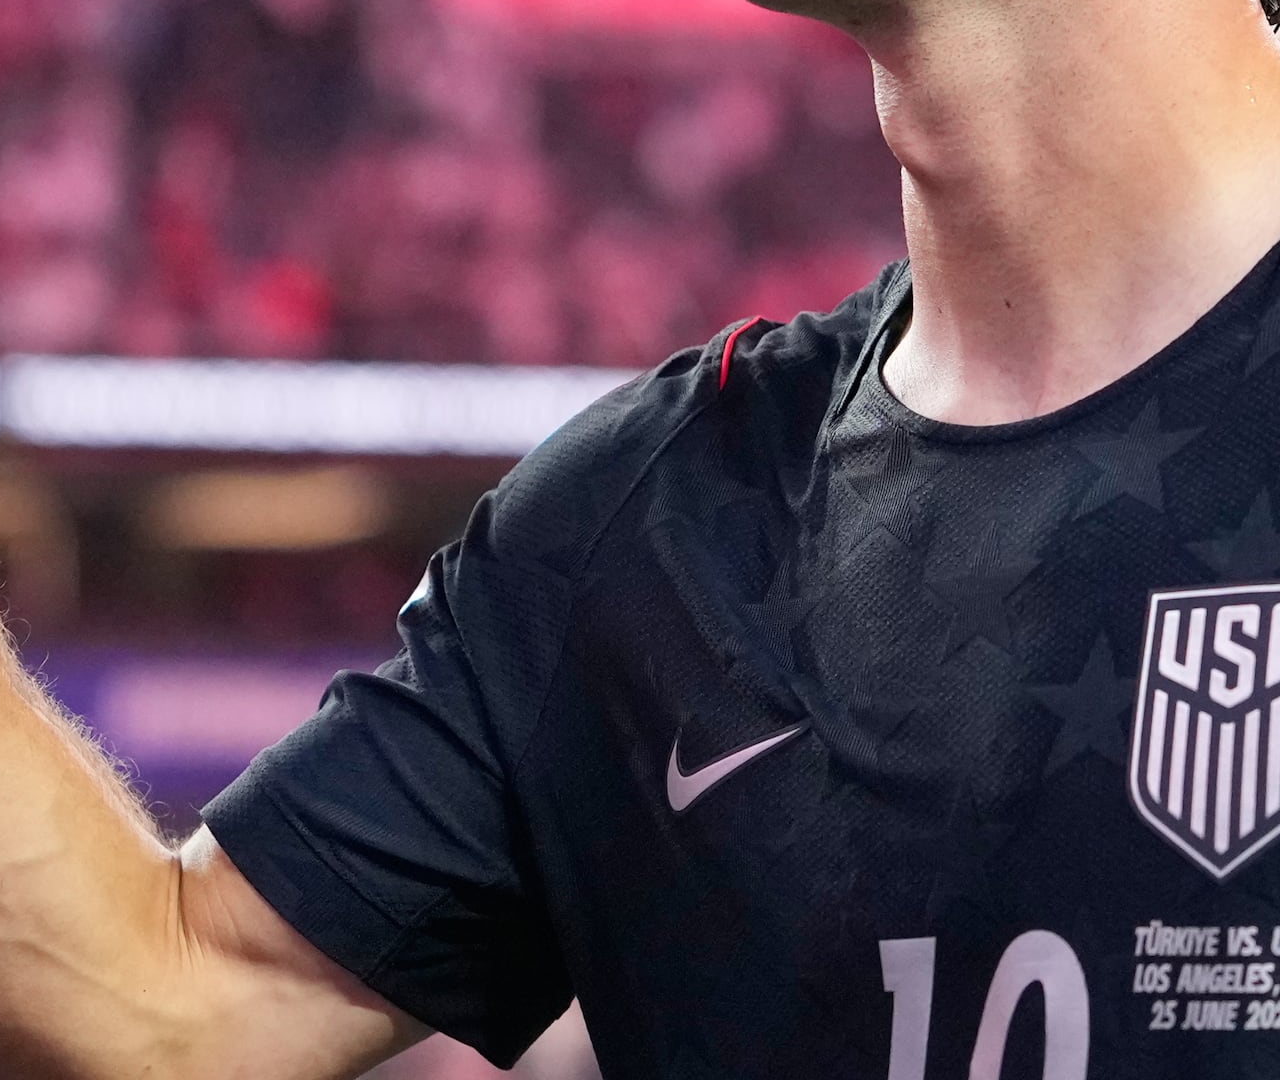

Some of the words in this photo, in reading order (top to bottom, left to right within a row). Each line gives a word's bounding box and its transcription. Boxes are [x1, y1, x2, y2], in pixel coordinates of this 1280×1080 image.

[1227, 925, 1263, 957] VS.
[1133, 962, 1172, 993] LOS
[1149, 1000, 1179, 1030] 25
[1180, 1000, 1241, 1030] JUNE
